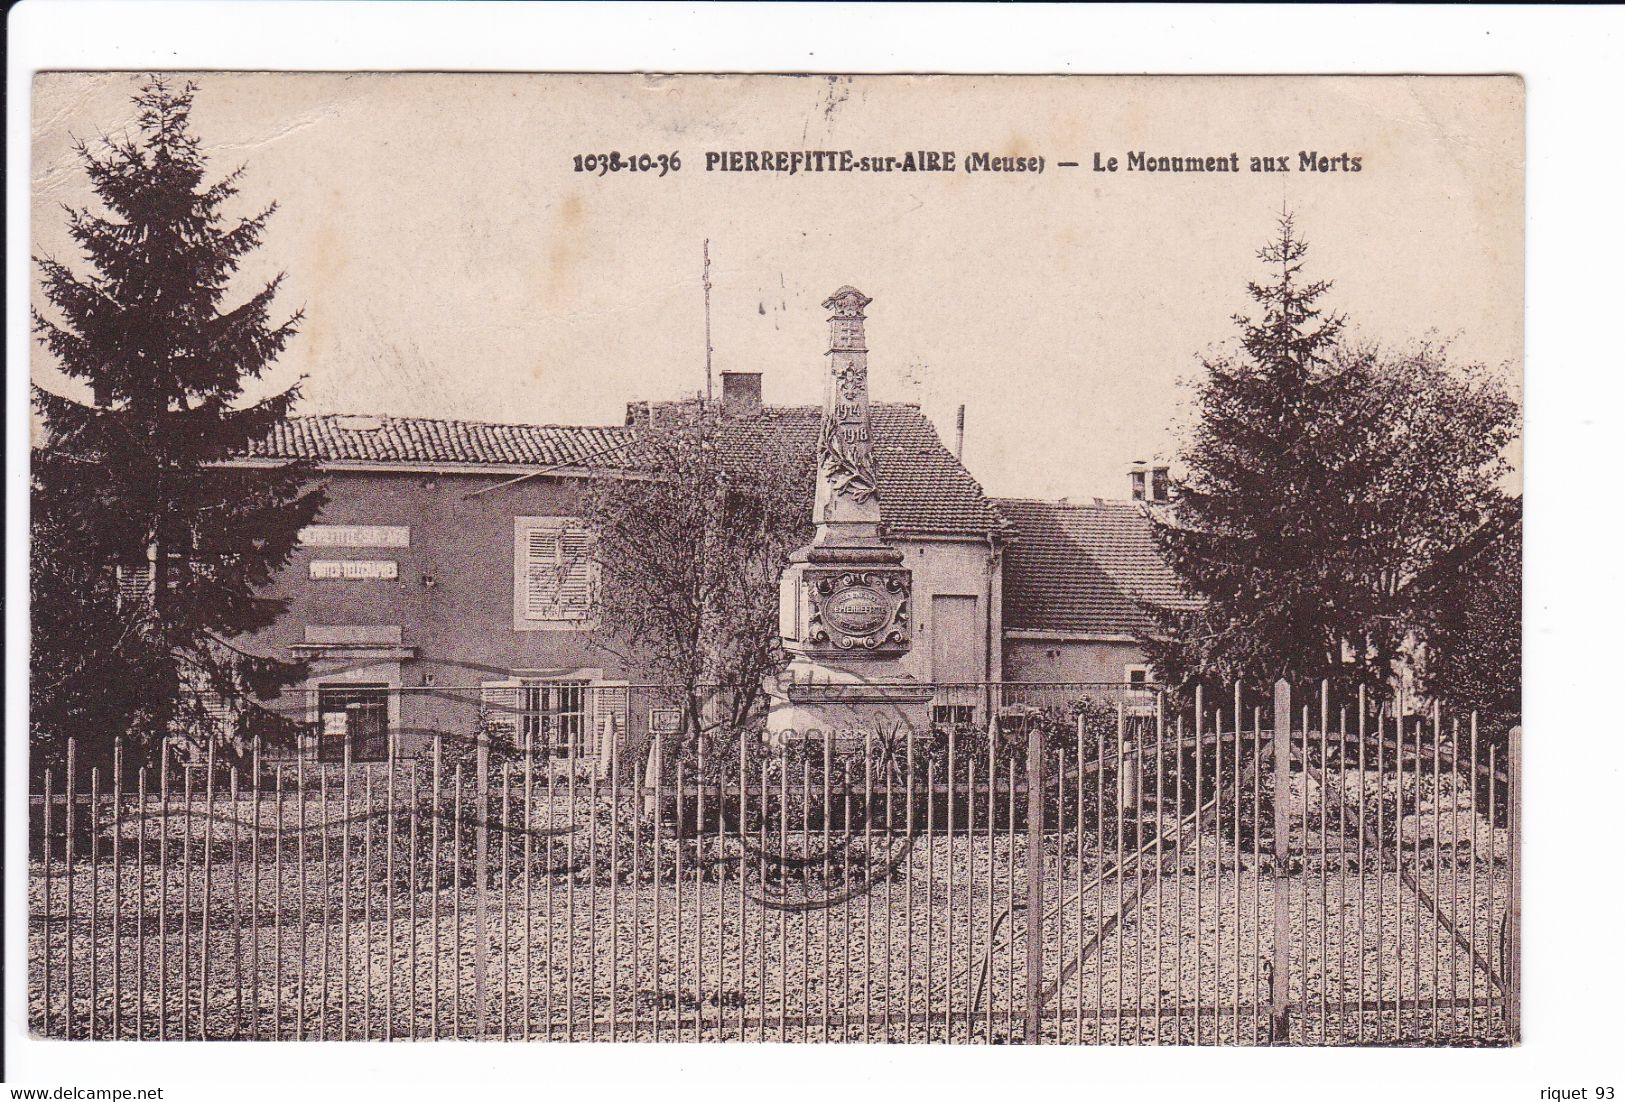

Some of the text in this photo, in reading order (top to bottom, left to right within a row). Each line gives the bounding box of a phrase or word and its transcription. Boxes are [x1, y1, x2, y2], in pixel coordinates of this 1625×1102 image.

[573, 151, 681, 177] 1038-10-36
[705, 150, 956, 175] PIERREFITTE-sur-AIRE
[964, 152, 1045, 175] (Meuse)
[1093, 152, 1118, 173] Le
[1127, 151, 1240, 173] Monument
[1250, 156, 1291, 173] aux
[1298, 151, 1362, 173] Morts
[836, 404, 860, 421] 1914
[844, 427, 868, 444] 1918
